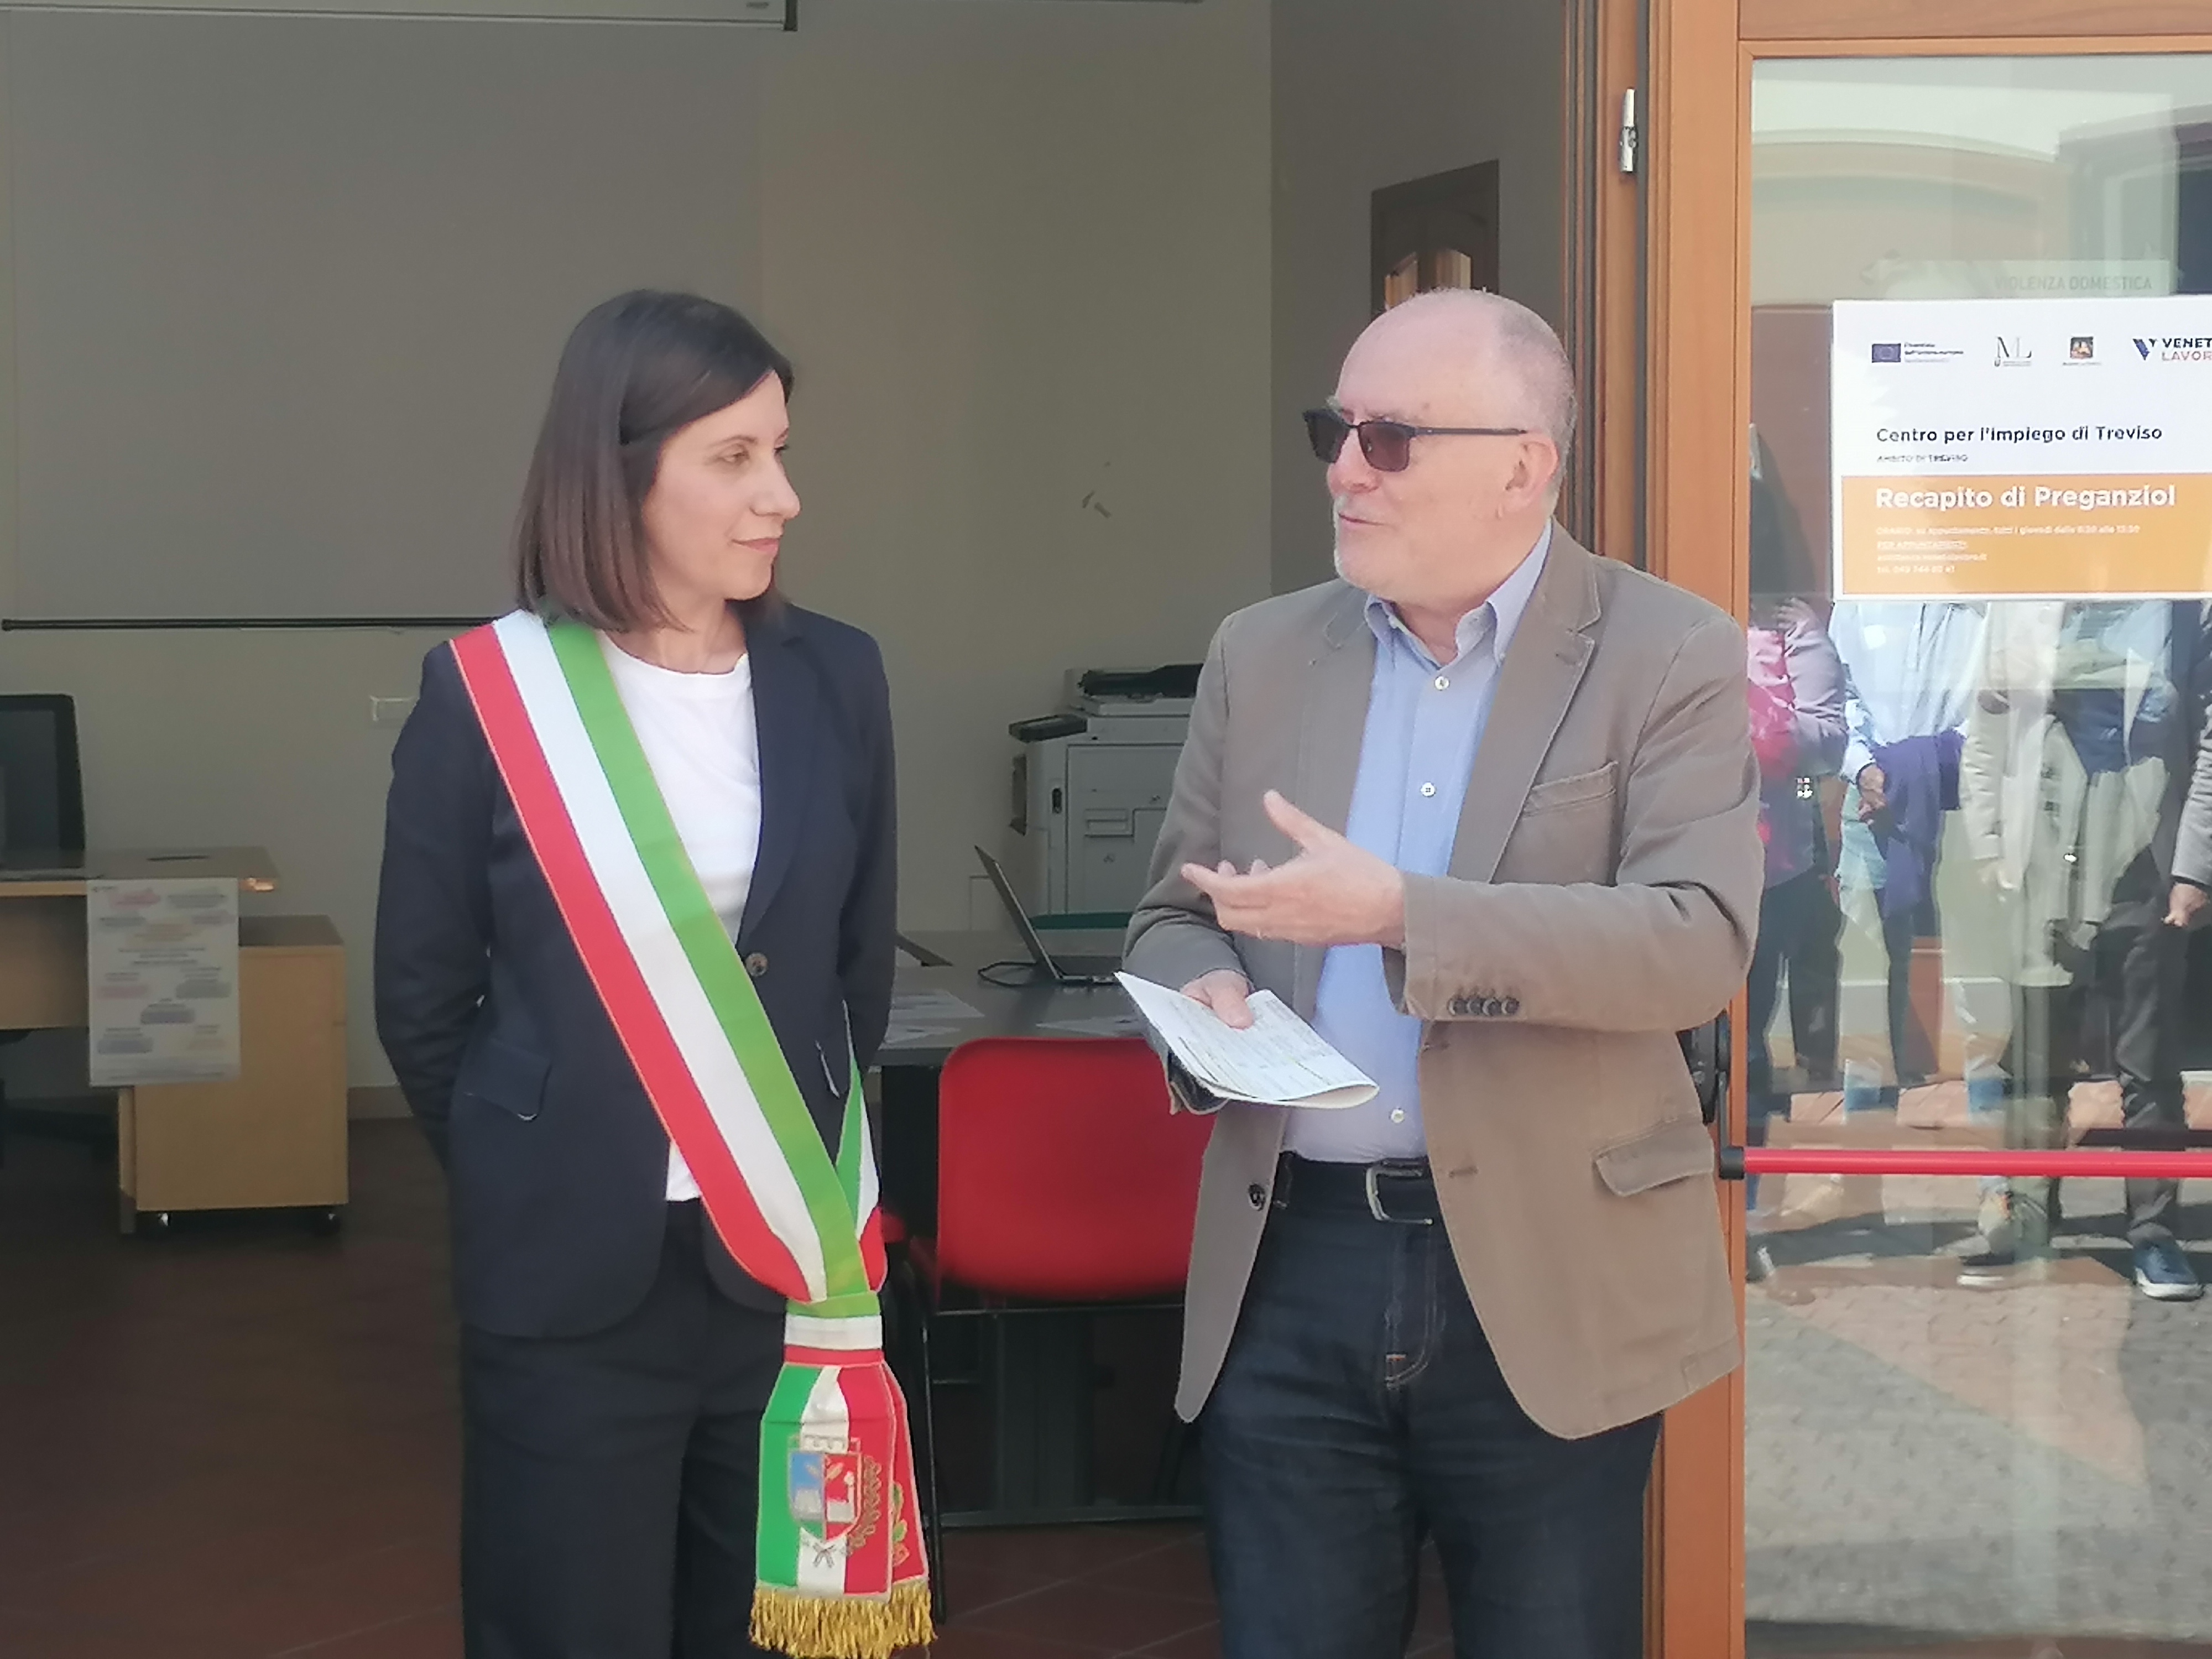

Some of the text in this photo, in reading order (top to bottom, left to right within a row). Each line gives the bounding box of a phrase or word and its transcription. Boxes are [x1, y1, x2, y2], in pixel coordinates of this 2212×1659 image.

[1995, 275, 2152, 290] VIOLENZA DOMESTICA
[1876, 428, 1937, 442] Centro
[1944, 430, 1974, 444] per
[2072, 425, 2089, 441] di
[2095, 425, 2162, 440] Treviso
[1876, 484, 2176, 512] Recapito di Preganziol
